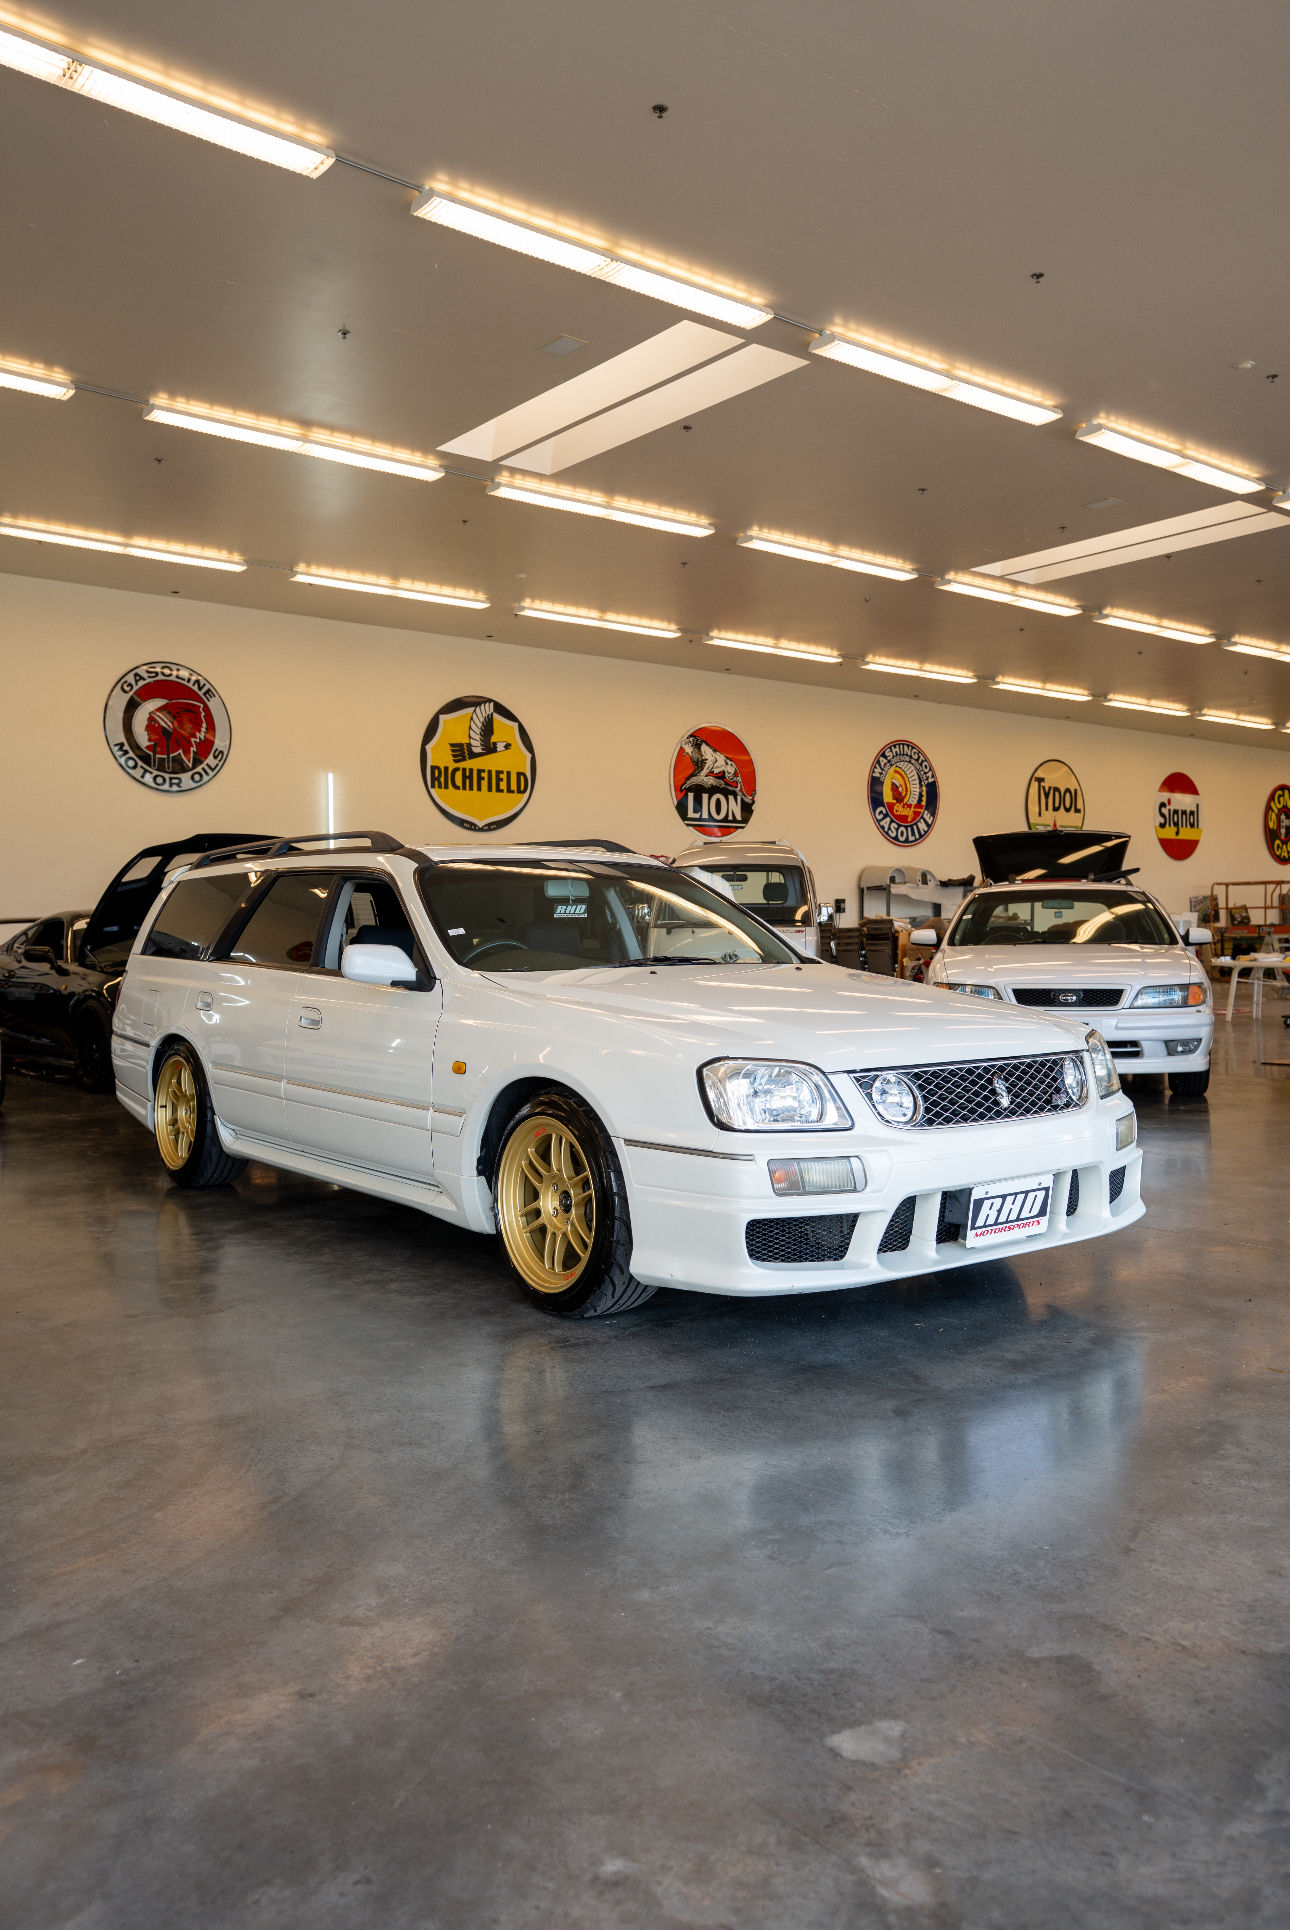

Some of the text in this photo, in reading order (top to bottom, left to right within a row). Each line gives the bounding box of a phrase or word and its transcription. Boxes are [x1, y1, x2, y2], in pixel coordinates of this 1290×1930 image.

[120, 665, 216, 702] GASOLINE
[113, 741, 225, 788] MOTOR OILS
[430, 765, 529, 795] RICHFIELD
[872, 744, 935, 783] WASHINGTON
[687, 792, 742, 821] LION
[893, 803, 923, 822] Chief
[1034, 777, 1082, 817] TYDOL
[875, 806, 934, 842] GASOLINE
[1158, 798, 1199, 837] Signal
[556, 904, 586, 914] RHD
[975, 1190, 1046, 1228] RHD
[974, 1219, 1041, 1238] MOTORSPORTS
